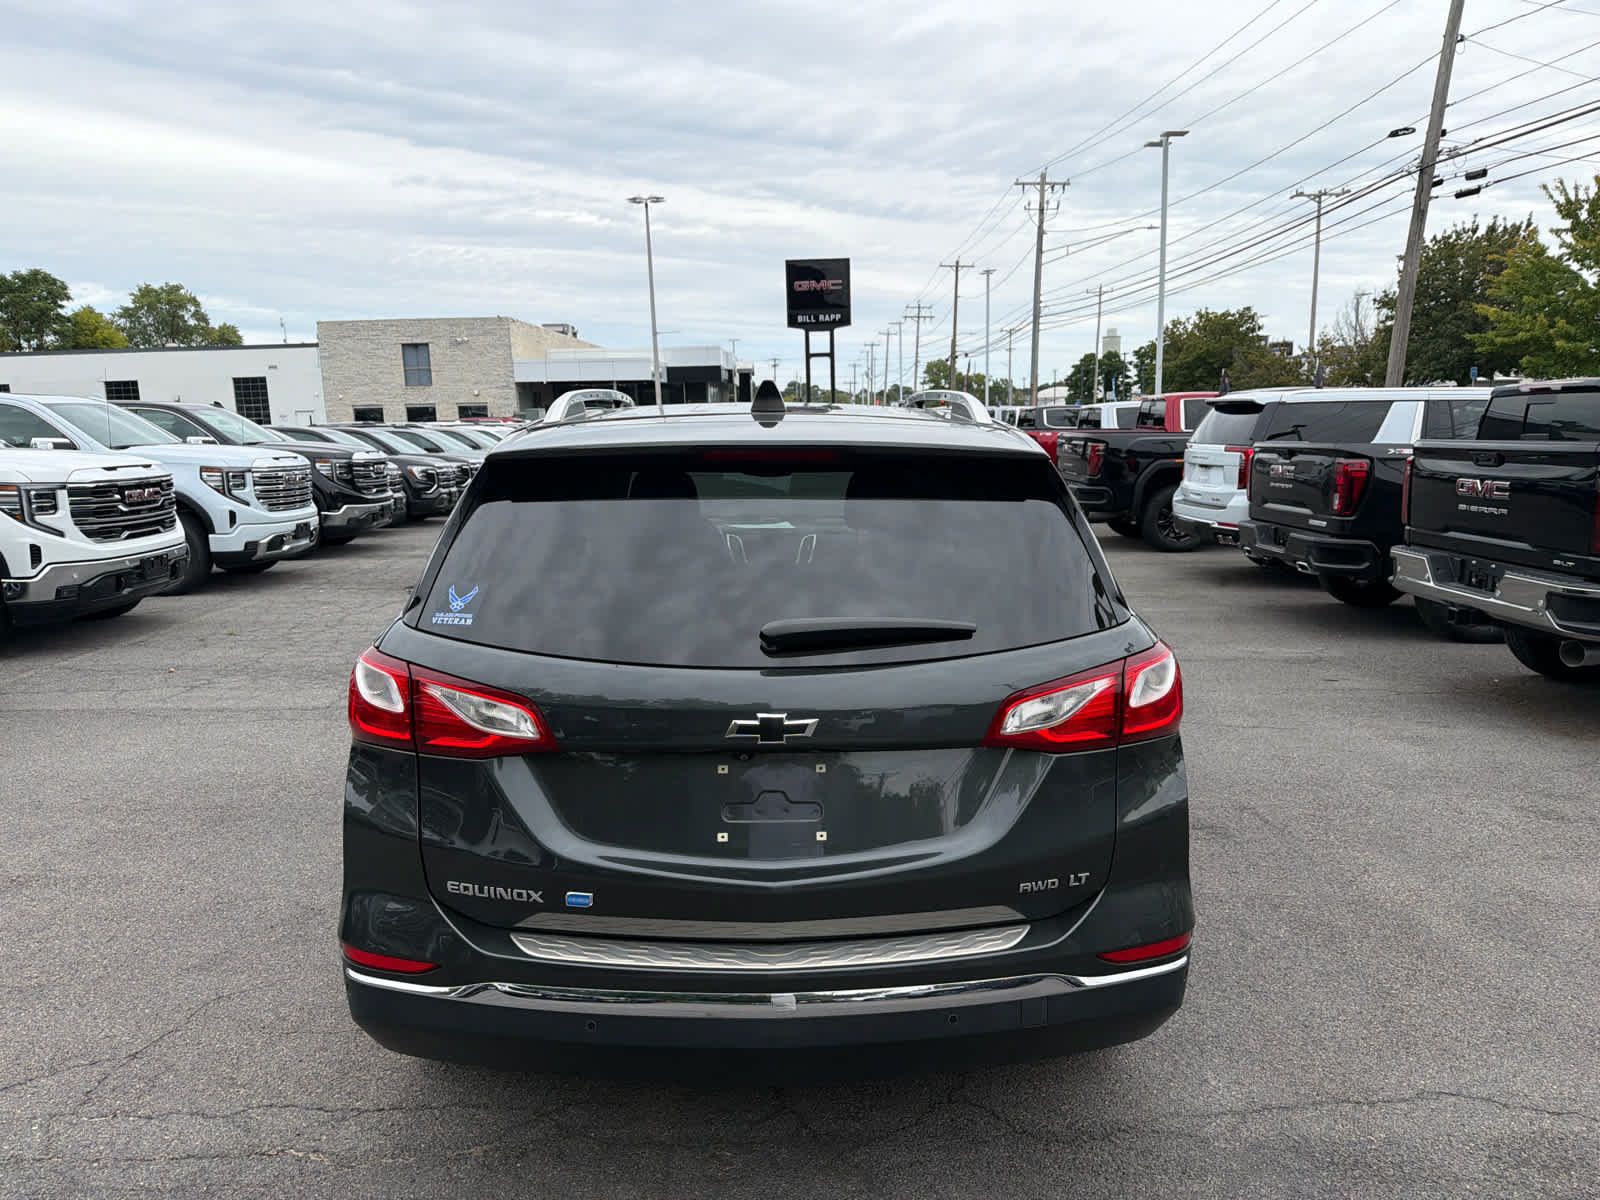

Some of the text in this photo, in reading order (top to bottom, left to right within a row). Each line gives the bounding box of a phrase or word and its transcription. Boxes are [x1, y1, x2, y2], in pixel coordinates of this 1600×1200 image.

[794, 280, 843, 292] GMC
[797, 313, 841, 323] BILL RAPP
[1456, 478, 1511, 498] GMC
[1457, 503, 1509, 515] SIERRA
[432, 616, 473, 625] VETERAN
[1019, 872, 1090, 893] AWD LT
[446, 880, 545, 904] EQUINOX
